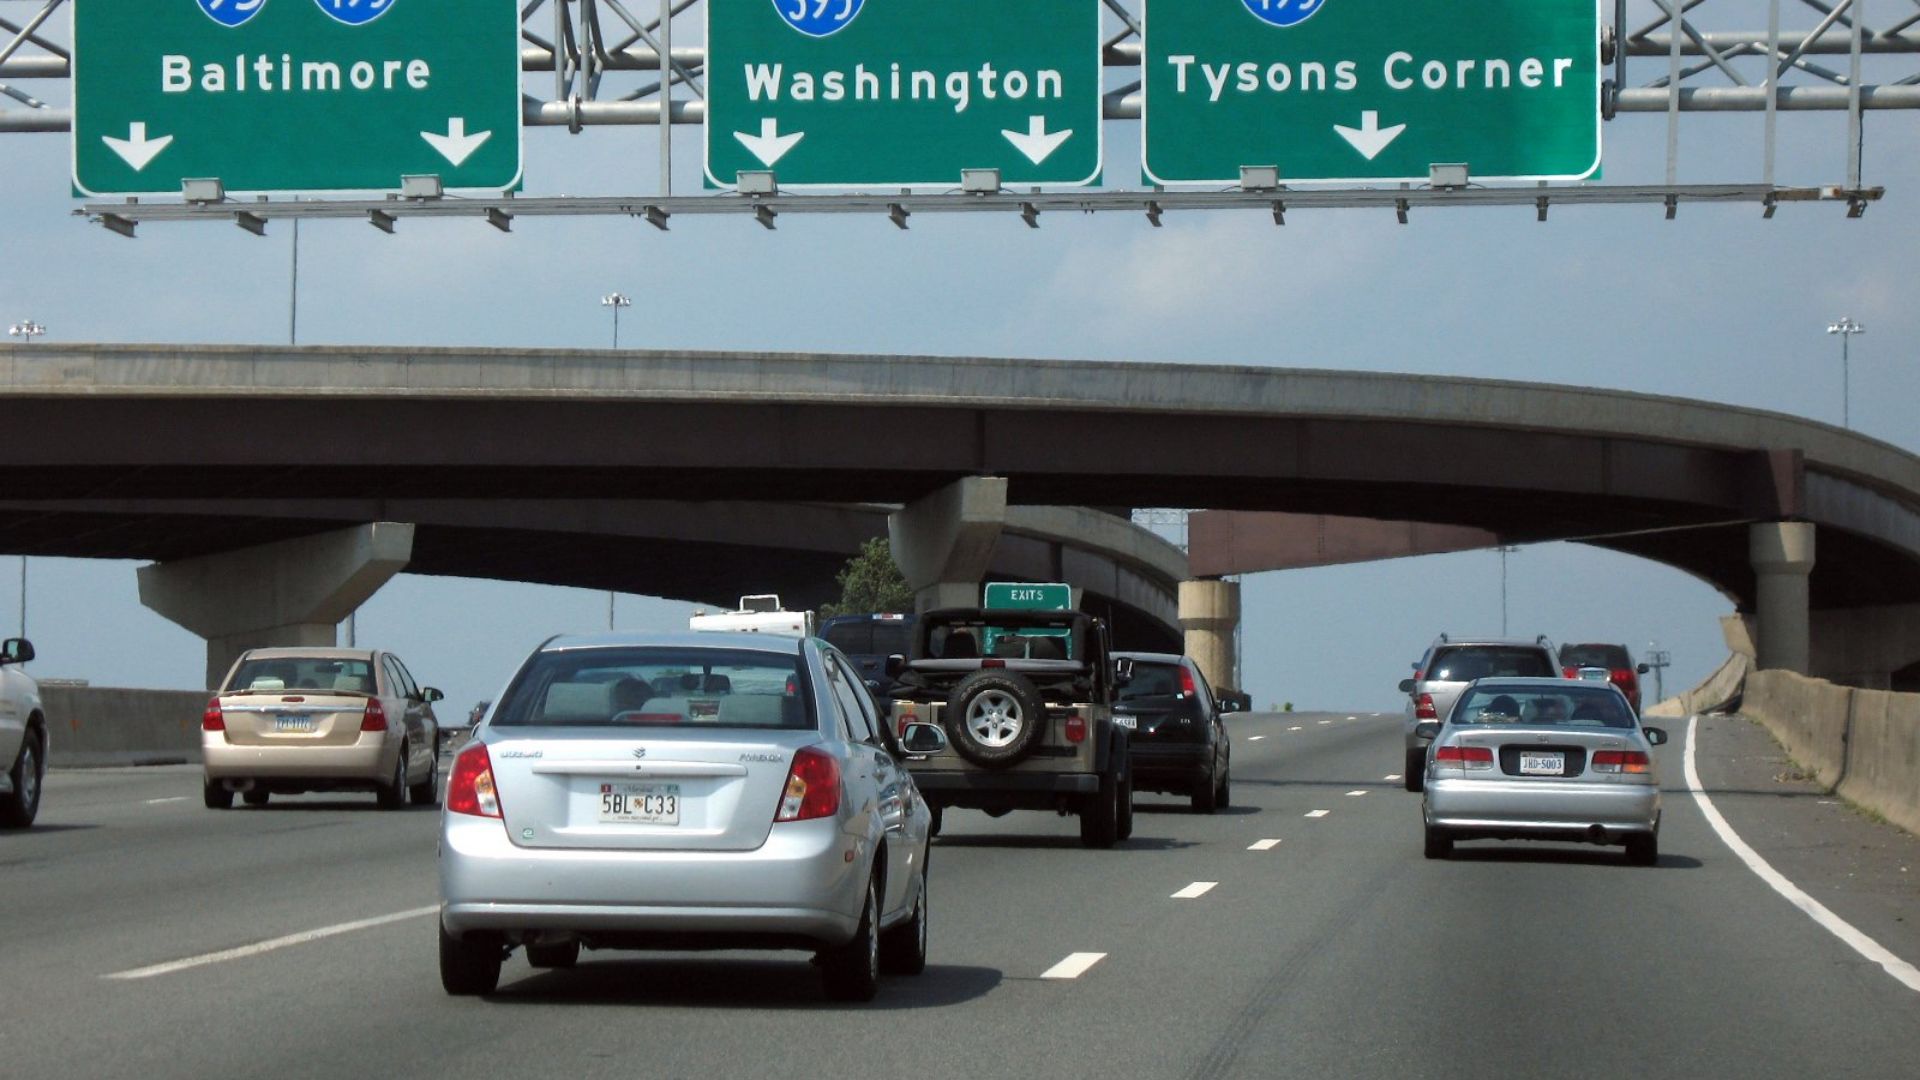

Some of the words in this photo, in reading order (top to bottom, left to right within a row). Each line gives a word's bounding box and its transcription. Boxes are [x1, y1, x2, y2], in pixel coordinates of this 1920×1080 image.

[162, 53, 431, 92] Baltimore
[744, 62, 1062, 113] Washington
[1167, 54, 1357, 103] Tysons
[1382, 51, 1573, 90] Corner
[1011, 589, 1044, 601] EXITS
[602, 794, 633, 814] 5BL
[644, 795, 676, 815] C33
